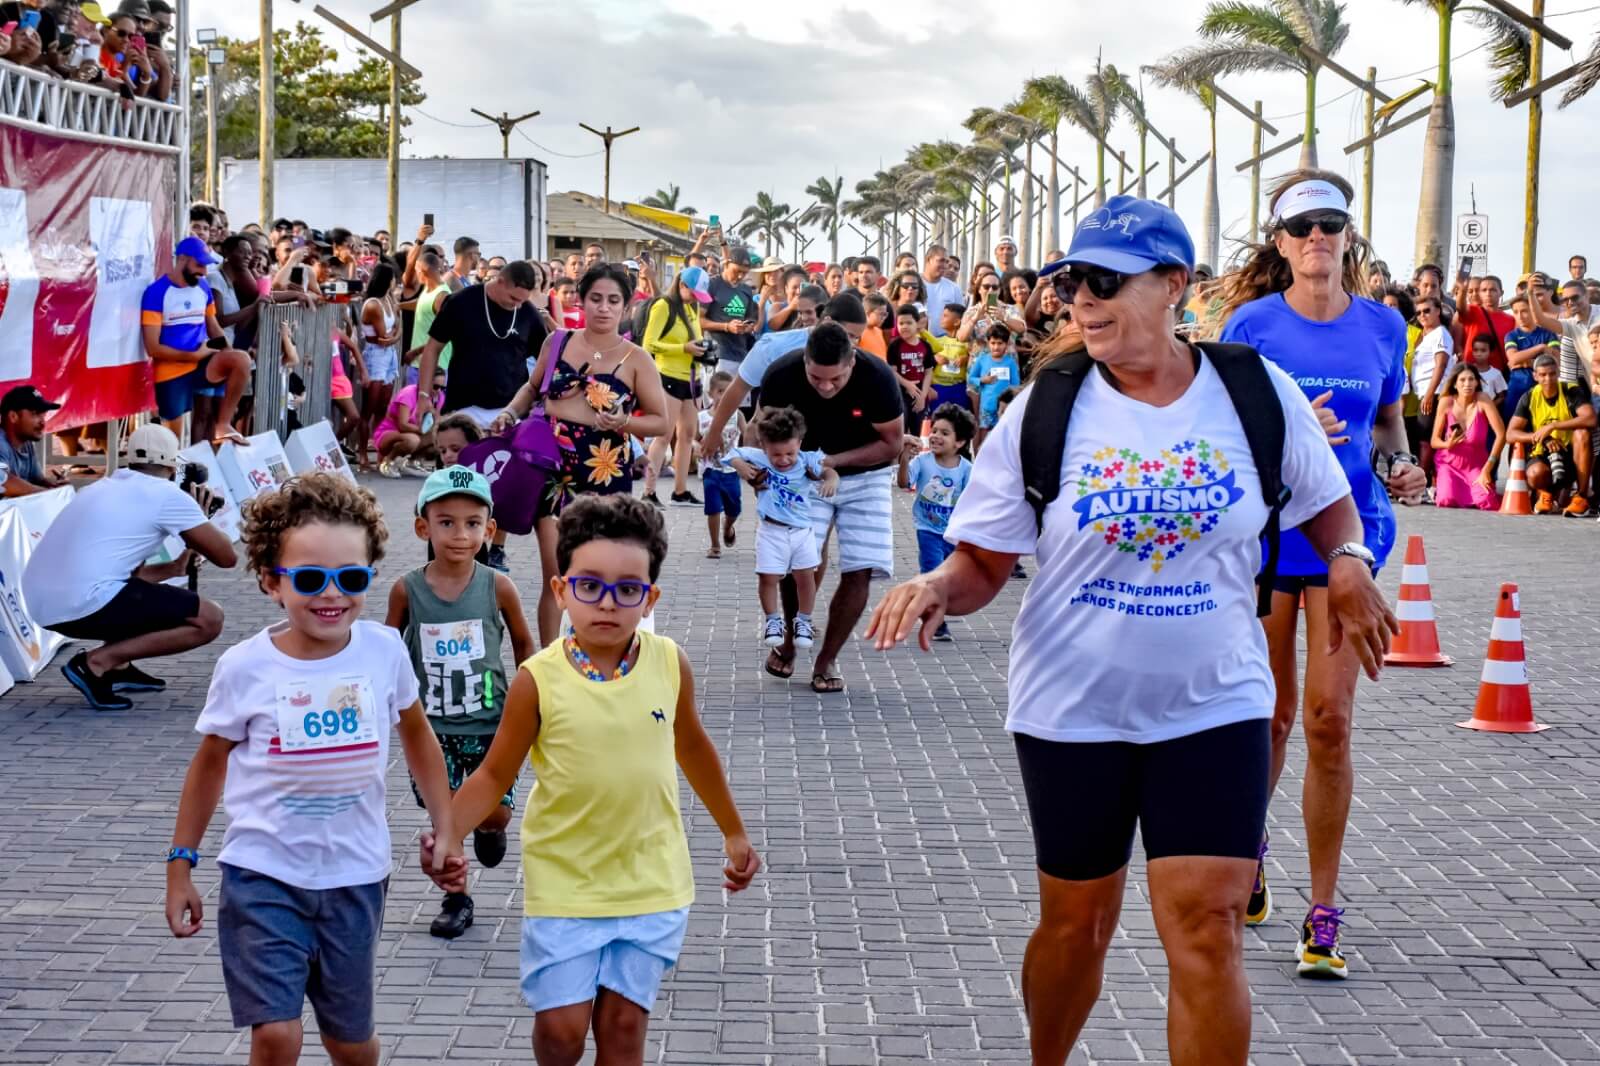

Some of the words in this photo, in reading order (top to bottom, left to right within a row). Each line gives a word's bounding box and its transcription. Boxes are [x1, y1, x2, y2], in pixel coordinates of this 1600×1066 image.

[1468, 224, 1478, 236] E
[1458, 241, 1486, 253] TÁXI
[449, 471, 473, 481] GOOD
[453, 479, 470, 488] DAY
[1089, 484, 1230, 520] AUTISMO
[435, 636, 472, 657] 604
[304, 707, 358, 738] 698
